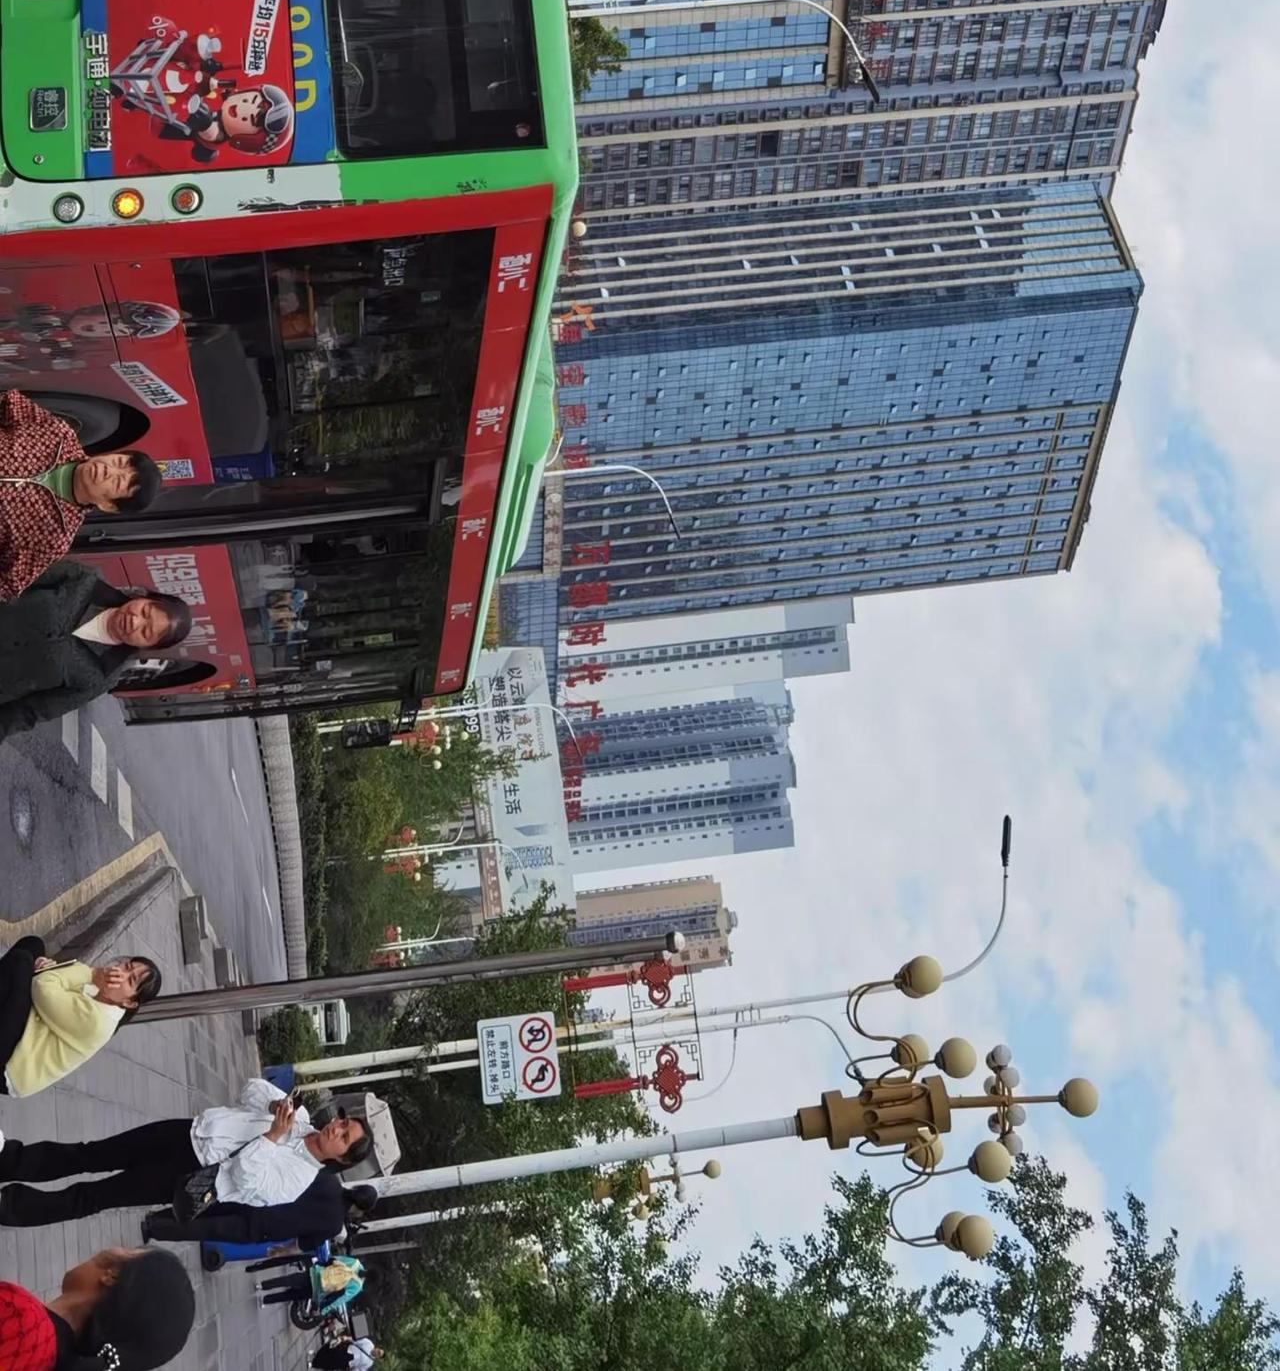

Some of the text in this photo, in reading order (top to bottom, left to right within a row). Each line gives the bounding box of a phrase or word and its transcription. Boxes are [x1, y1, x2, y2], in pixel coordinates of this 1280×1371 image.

[497, 252, 533, 293] 酒小二
[475, 406, 505, 436] 酒小二
[499, 1040, 511, 1079] 前方路口
